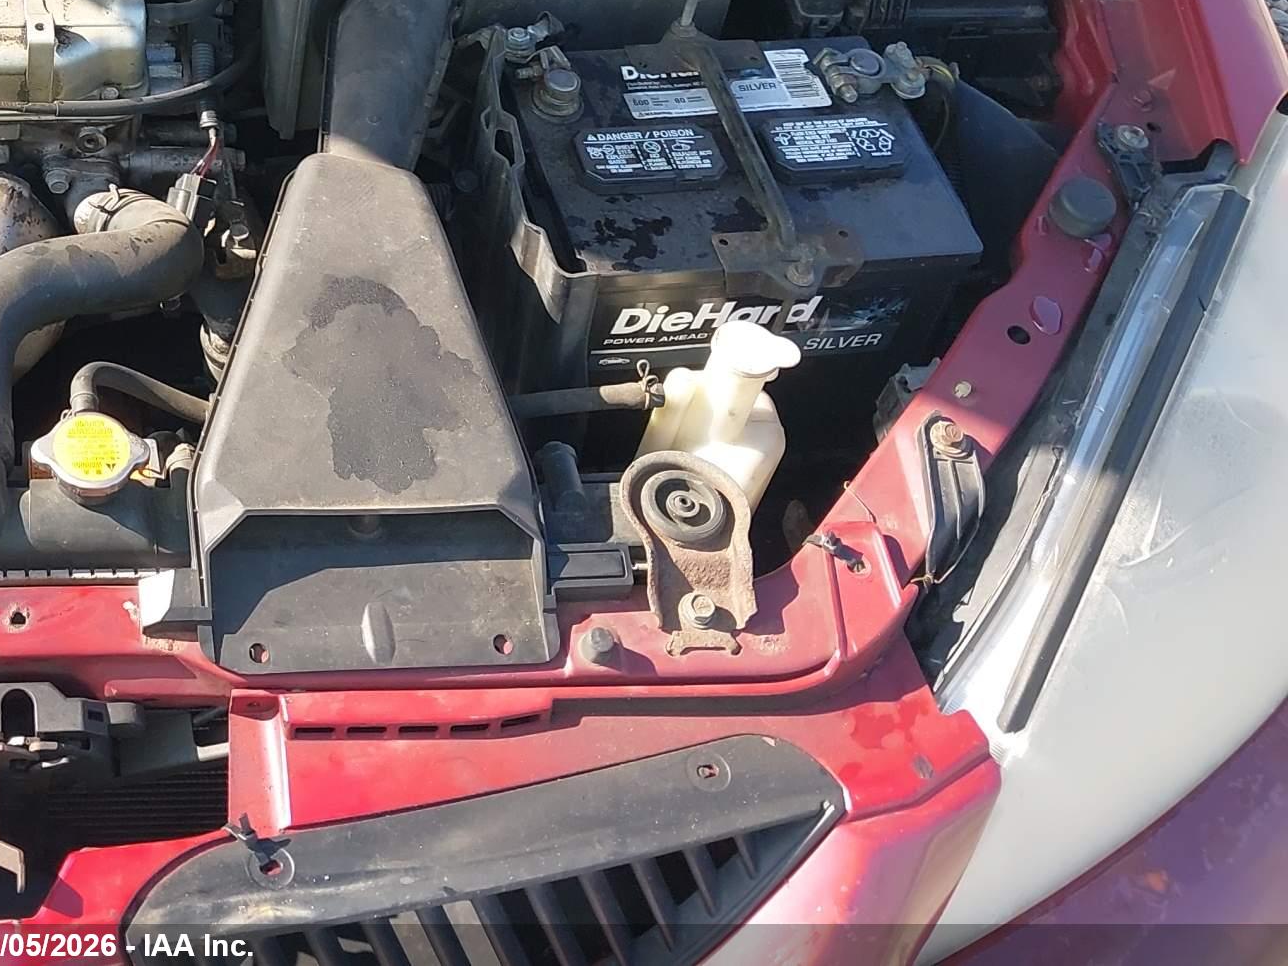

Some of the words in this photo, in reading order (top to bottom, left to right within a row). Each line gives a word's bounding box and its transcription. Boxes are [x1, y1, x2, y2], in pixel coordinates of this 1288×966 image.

[738, 82, 777, 93] SILVER
[596, 131, 643, 141] DANGER
[652, 128, 695, 138] POISON
[611, 295, 823, 335] DieHard
[603, 337, 654, 346] POWER
[657, 332, 707, 344] AHEAD
[803, 333, 883, 351] SILVER
